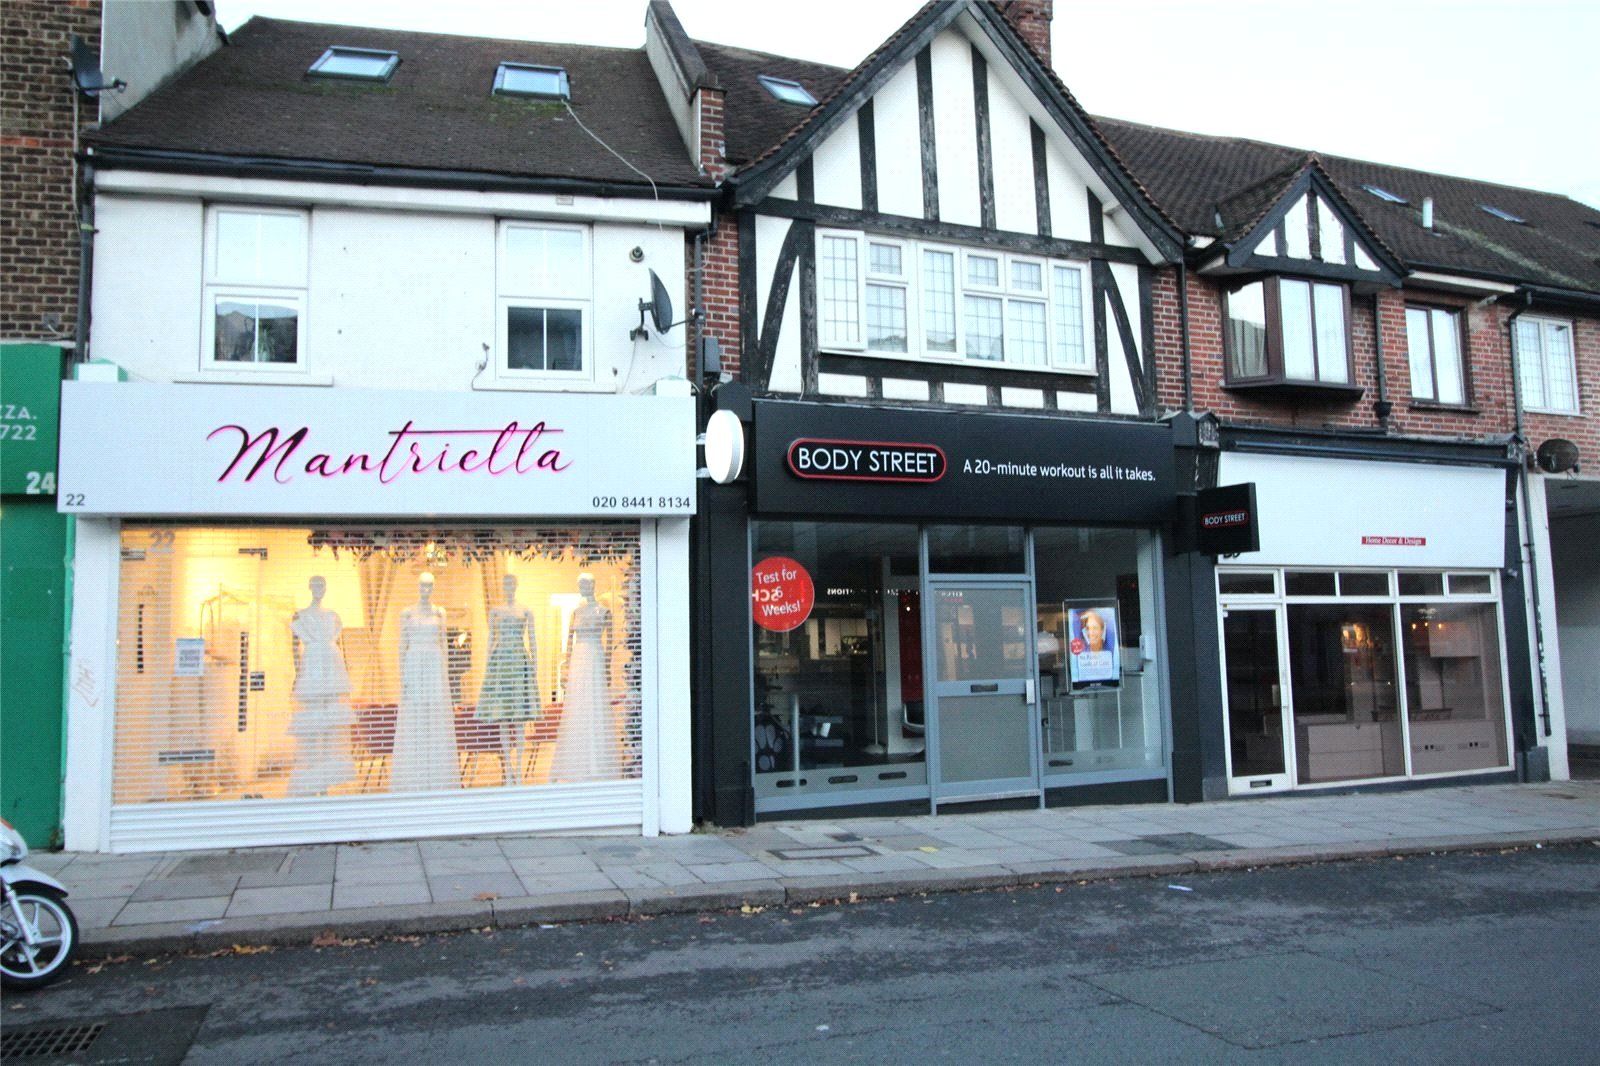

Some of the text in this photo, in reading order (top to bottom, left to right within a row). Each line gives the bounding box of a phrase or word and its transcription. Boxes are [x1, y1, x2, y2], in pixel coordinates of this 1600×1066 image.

[0, 404, 37, 420] ZA.
[206, 420, 574, 485] Mantriella
[798, 447, 937, 474] BODY STREET
[963, 459, 1156, 481] A 20-minute workout is all it takes.
[25, 470, 56, 495] 24
[65, 493, 85, 506] 22
[592, 496, 690, 508] 020 8441 8134
[1204, 512, 1246, 525] BODY STREET
[756, 567, 797, 585] Test for
[762, 600, 801, 617] Weeks!
